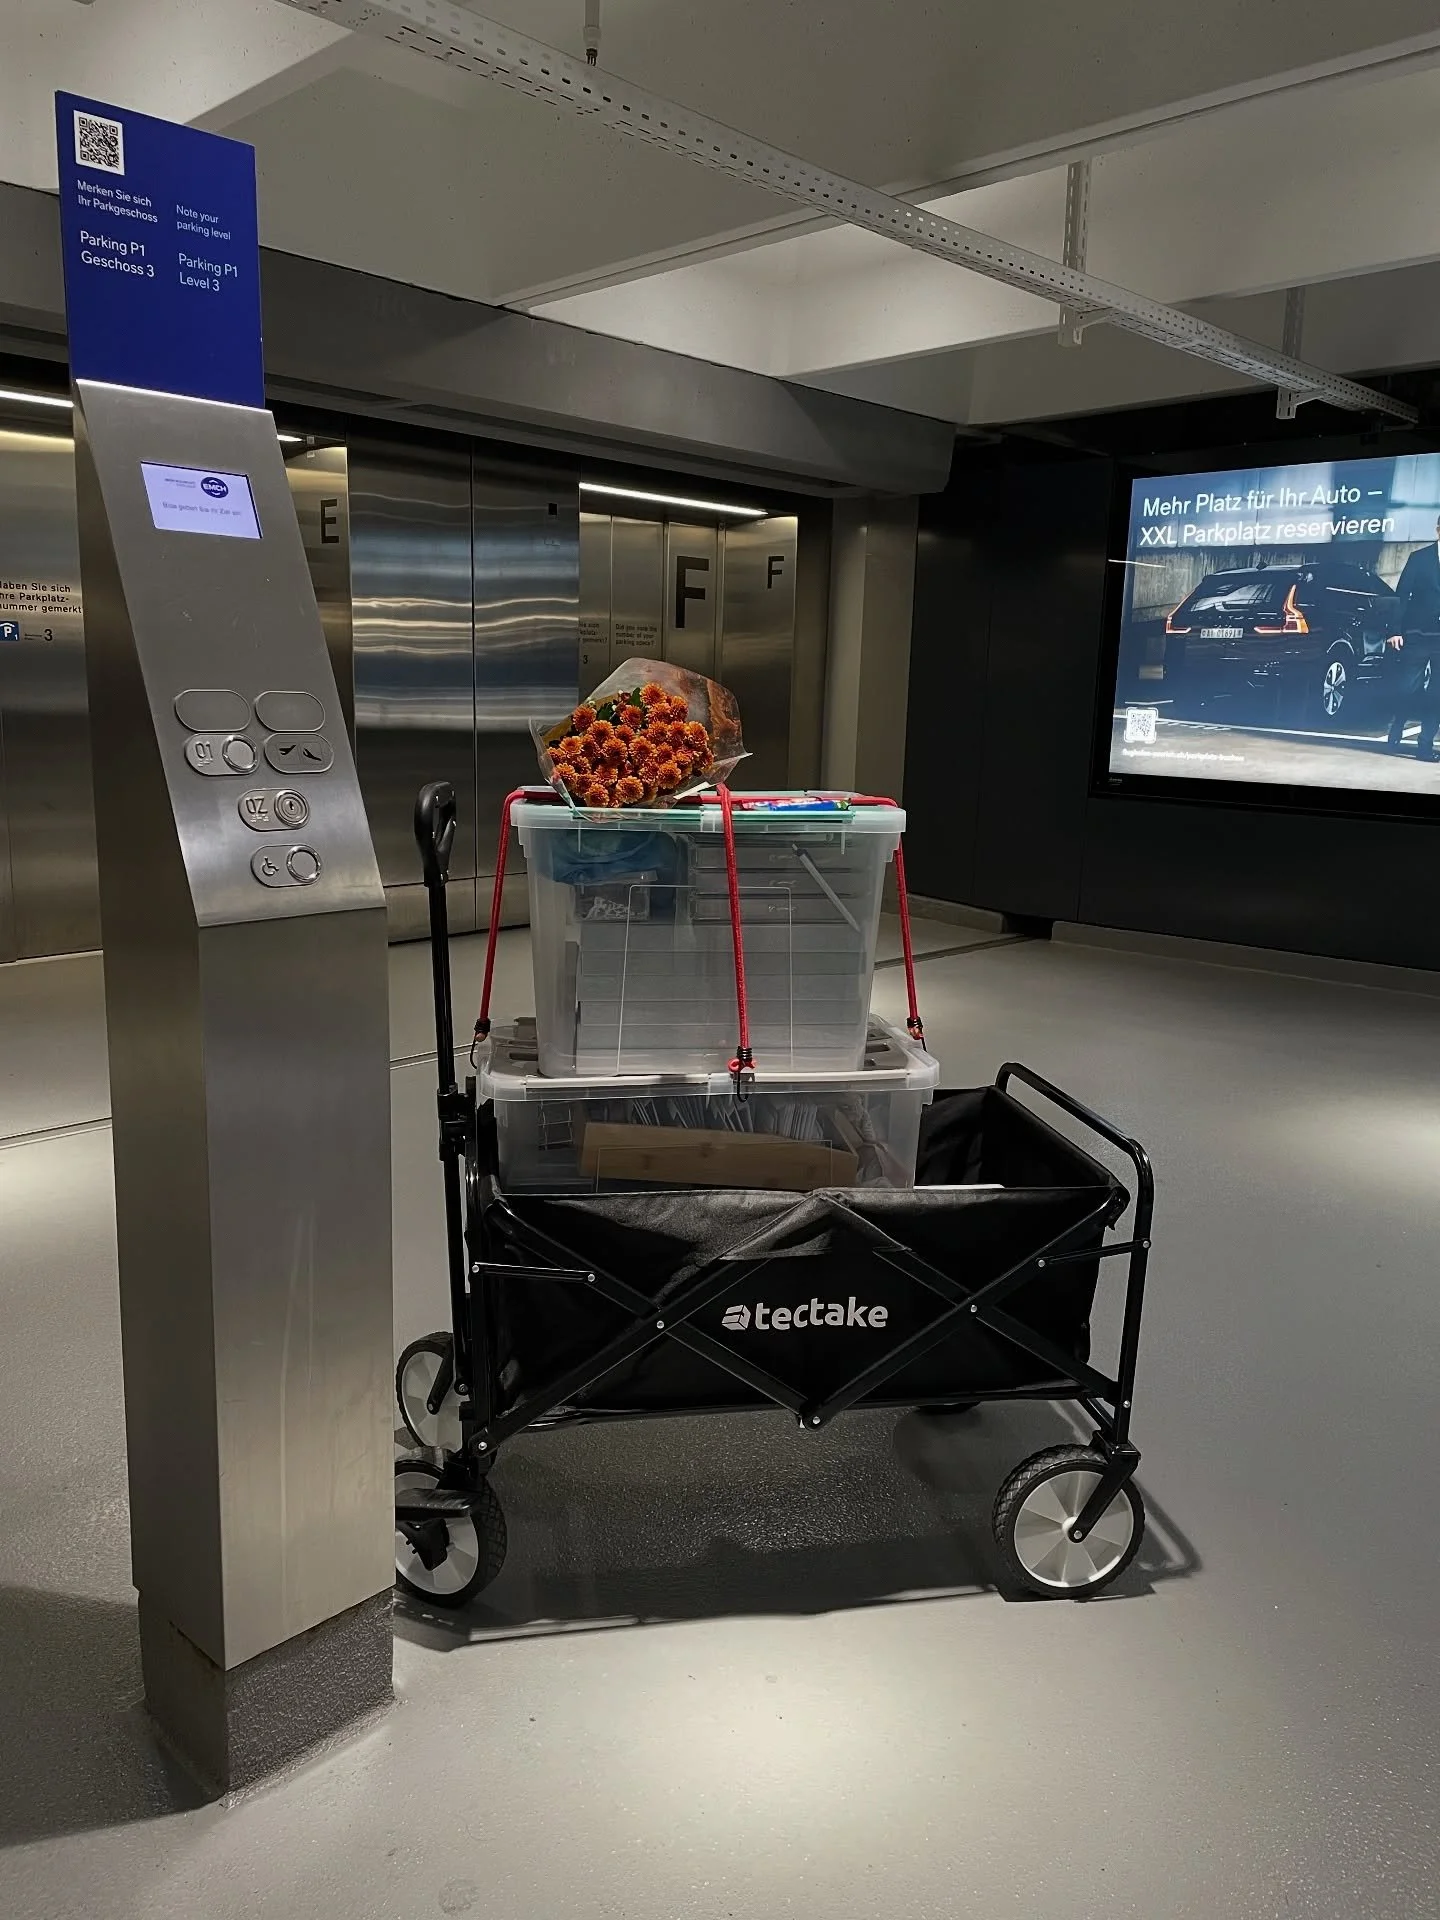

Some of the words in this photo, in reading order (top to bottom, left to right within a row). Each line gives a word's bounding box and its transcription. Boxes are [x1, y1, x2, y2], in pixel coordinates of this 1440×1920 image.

[77, 180, 113, 197] Merken
[116, 190, 131, 201] Sie
[133, 195, 151, 207] sich
[78, 195, 91, 206] Ihr
[93, 198, 158, 223] Parkgeschoss
[176, 204, 198, 218] Note
[200, 213, 218, 223] your
[80, 230, 127, 255] Parking
[131, 242, 145, 256] P1
[177, 221, 209, 237] parking
[211, 227, 231, 240] level
[81, 251, 143, 275] Geschoss
[146, 265, 154, 277] 3
[179, 252, 221, 276] Parking
[225, 264, 238, 277] P1
[180, 272, 209, 289] Level
[213, 279, 220, 291] 3
[203, 483, 227, 493] EMCH
[1143, 498, 1191, 517] Mehr
[1195, 493, 1241, 513] Platz
[1247, 490, 1274, 509] für
[1279, 487, 1306, 507] Ihr
[1310, 484, 1360, 505] Auto
[321, 499, 339, 544] E
[1140, 525, 1177, 546] XXL
[1183, 520, 1271, 546] Parkplatz
[1276, 516, 1395, 539] reservieren
[767, 555, 784, 589] F
[20, 593, 69, 603] Parkplatz-
[32, 583, 47, 591] Sie
[51, 584, 71, 593] sich
[675, 555, 710, 628] F
[42, 605, 82, 613] gemerkt
[44, 629, 53, 641] 3
[583, 655, 588, 664] 3
[755, 1296, 888, 1330] tectake
